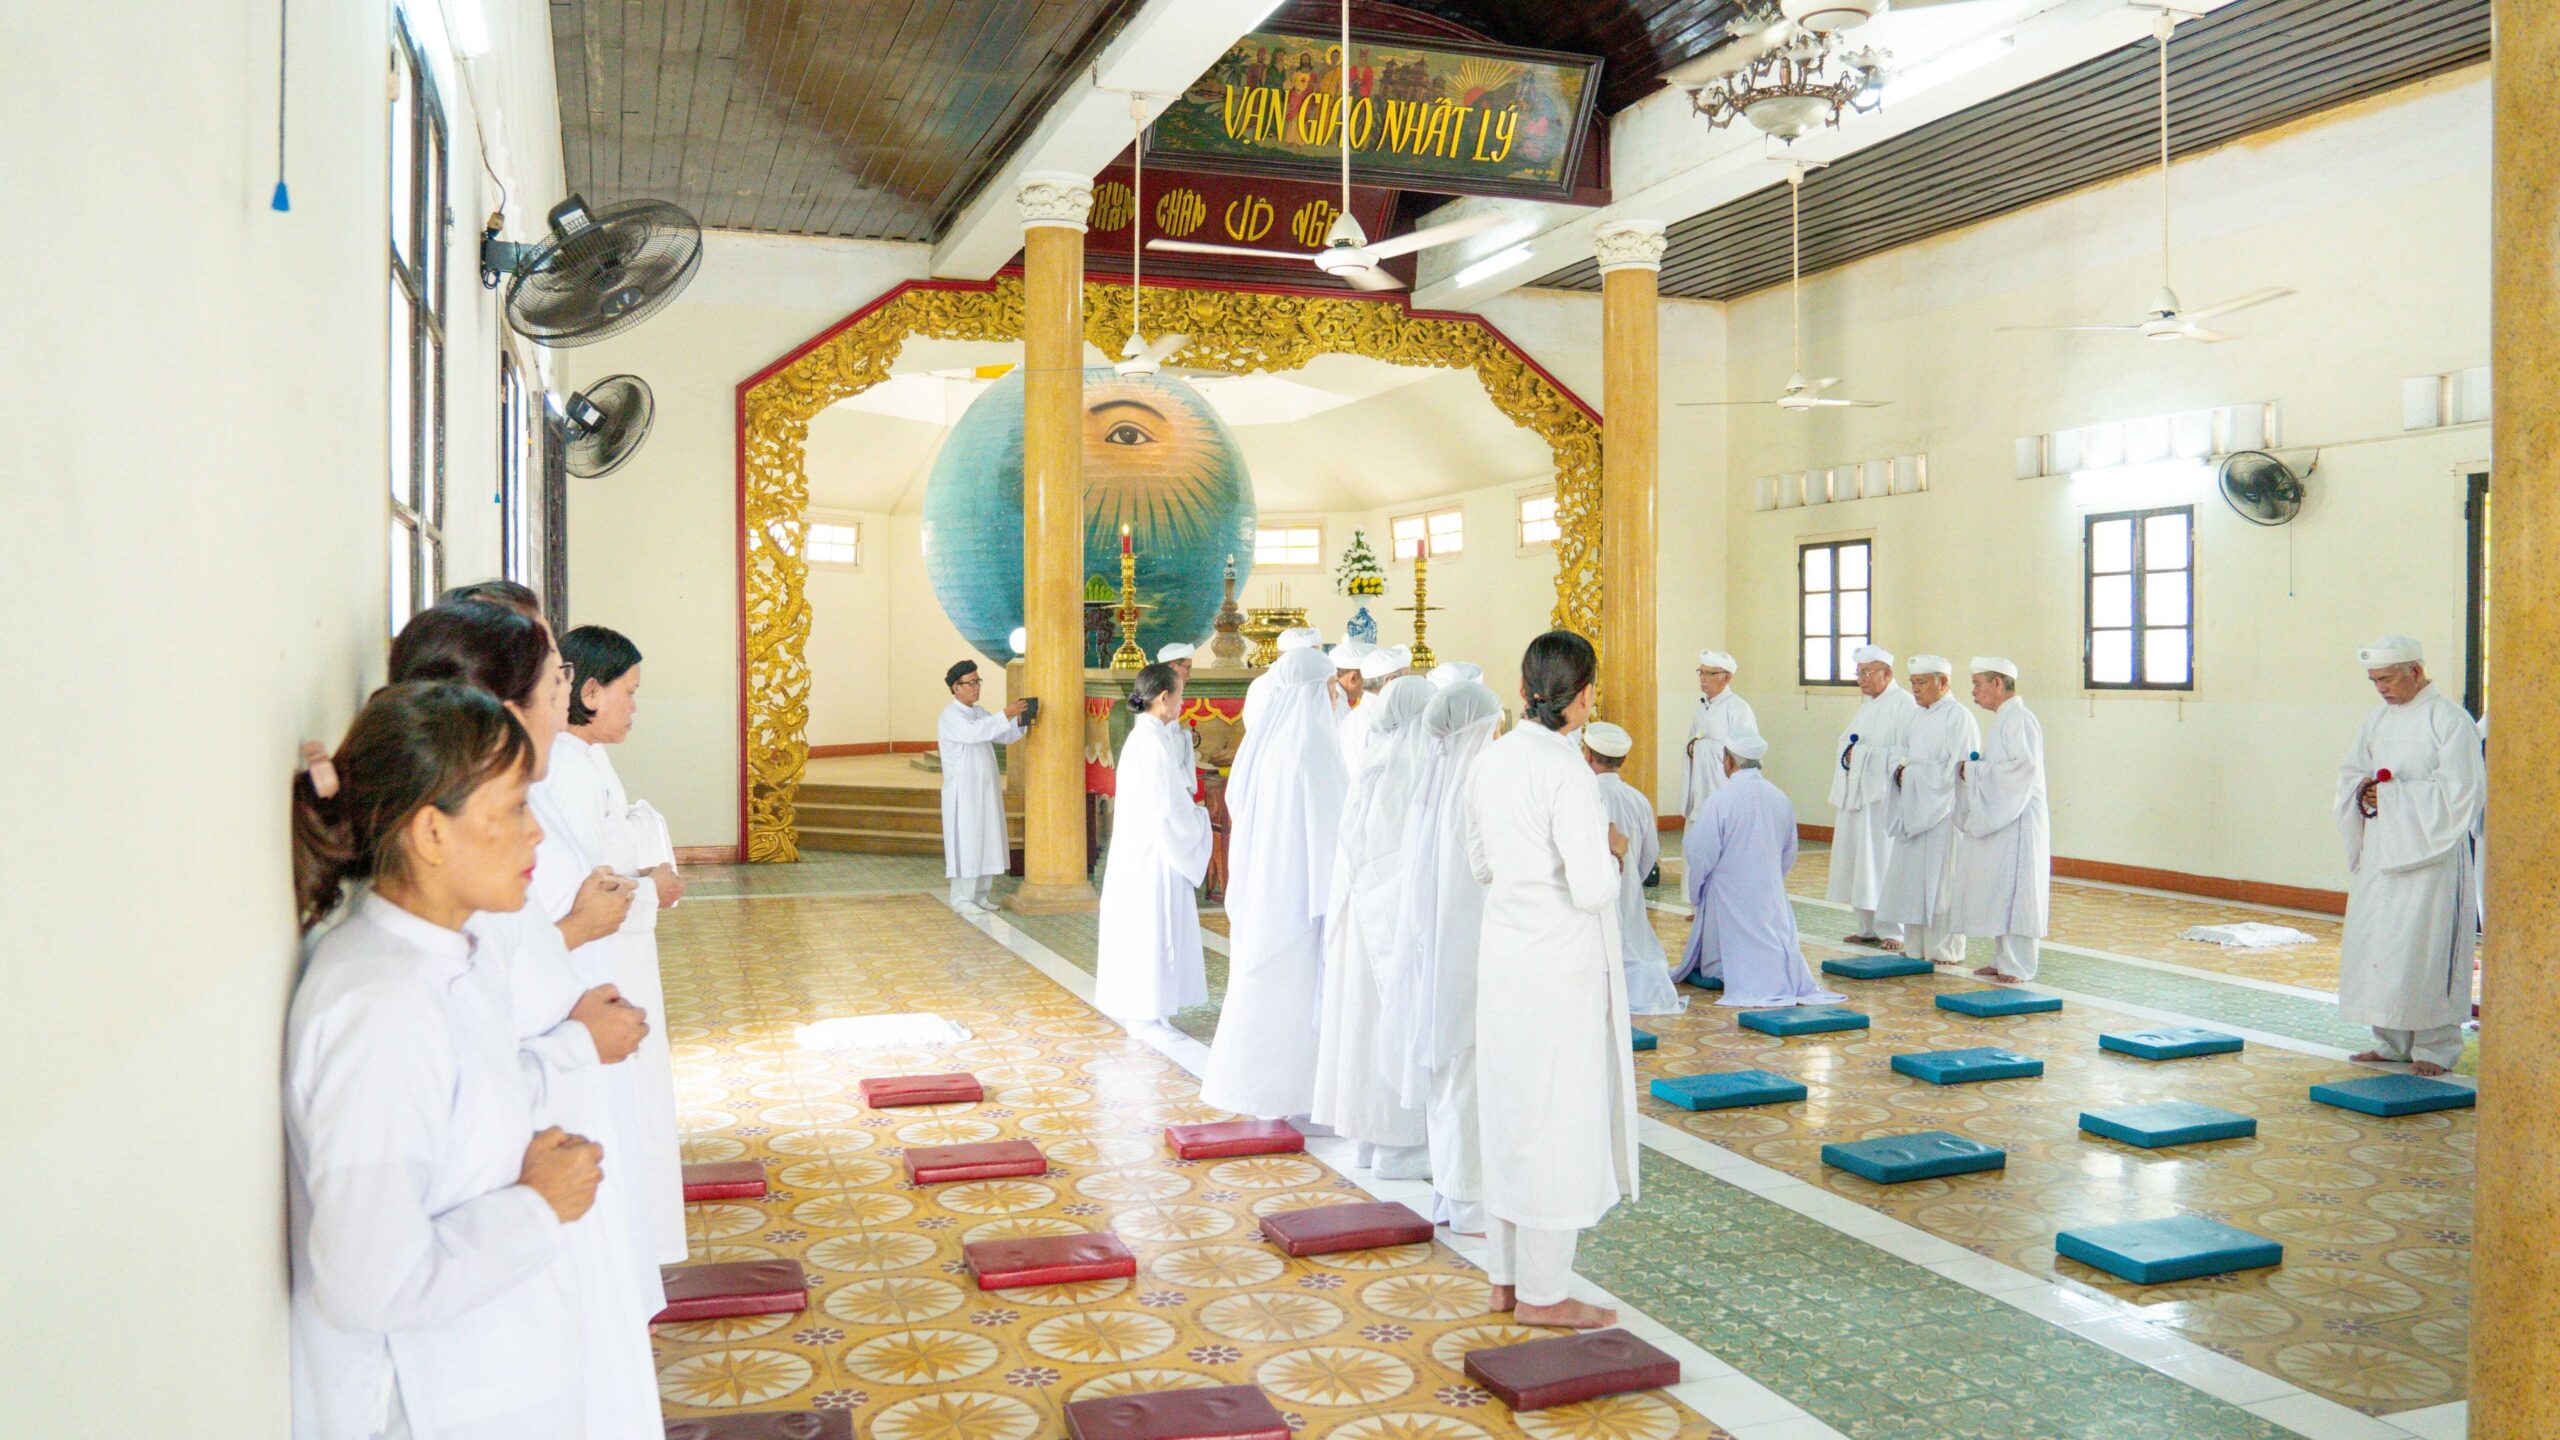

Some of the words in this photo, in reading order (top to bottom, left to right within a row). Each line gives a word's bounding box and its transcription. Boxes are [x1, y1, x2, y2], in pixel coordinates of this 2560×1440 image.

[1224, 83, 1290, 145] VẠN
[1376, 97, 1473, 159] NHẤT
[1472, 104, 1518, 163] LÝ
[1156, 188, 1206, 237] CHÂN
